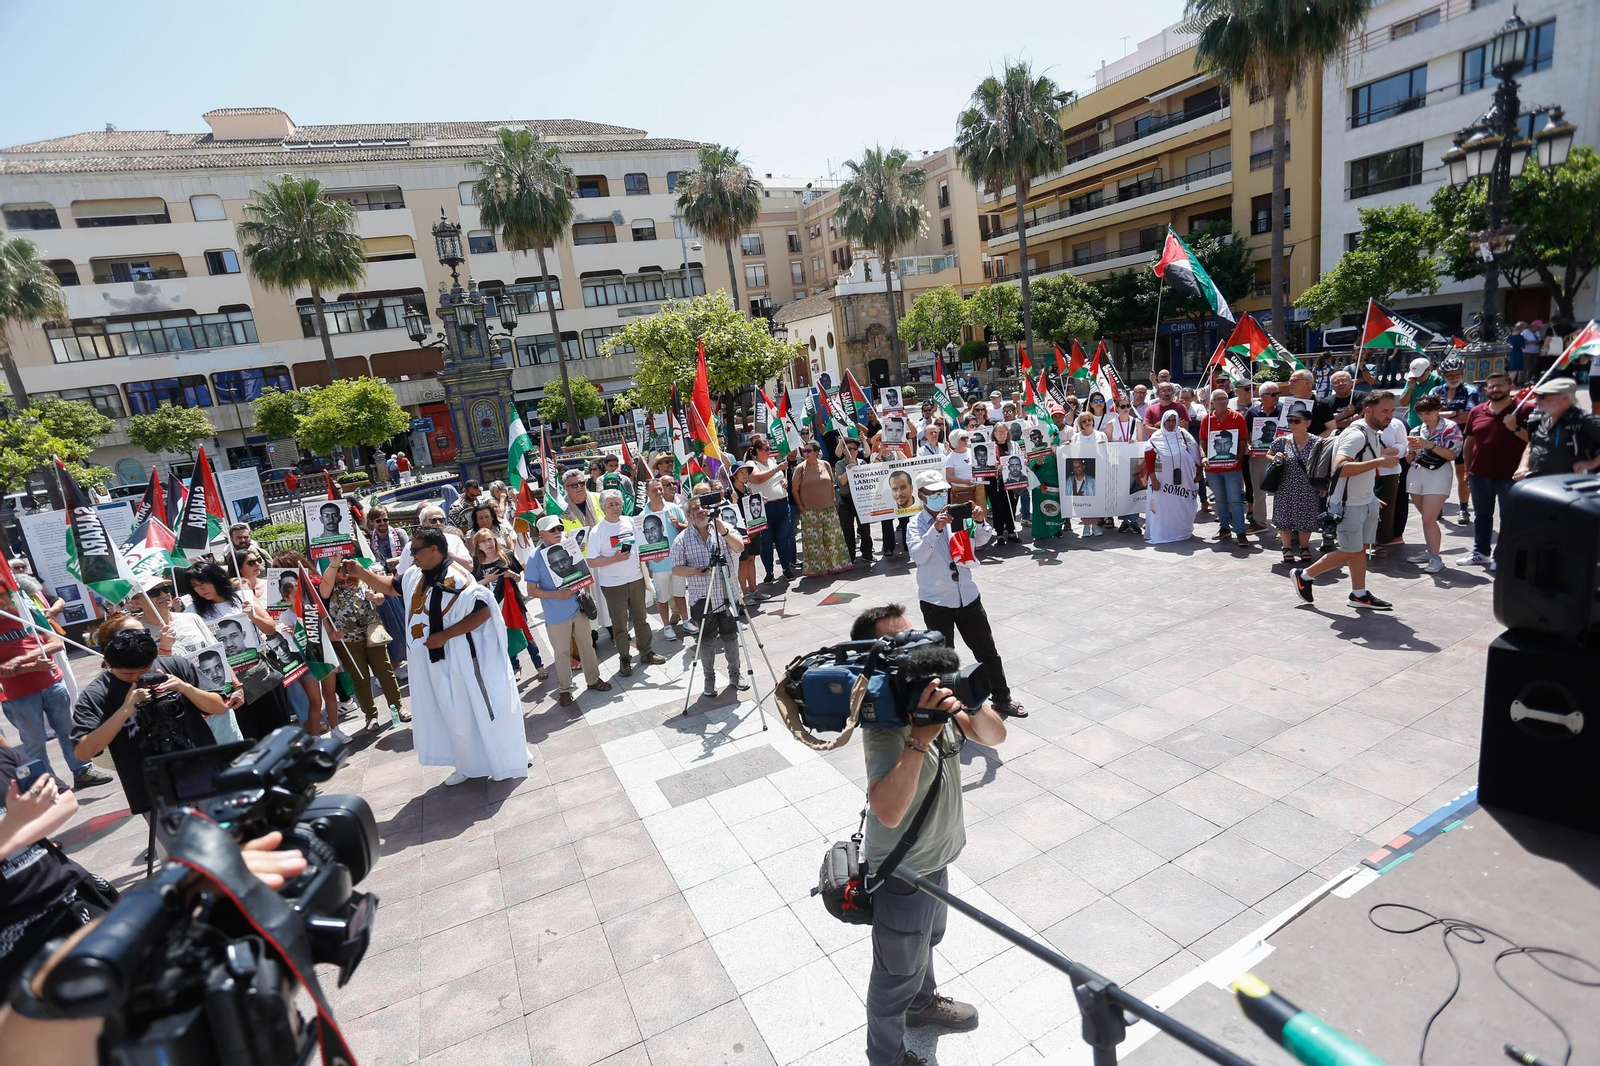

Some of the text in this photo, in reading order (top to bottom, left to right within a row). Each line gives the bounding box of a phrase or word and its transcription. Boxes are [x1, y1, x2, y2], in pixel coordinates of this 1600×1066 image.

[1391, 316, 1418, 340] SAHARA
[1395, 334, 1416, 349] LIBRE
[841, 391, 855, 416] SAHARA
[934, 391, 950, 409] LIBRE
[1050, 387, 1066, 406] SAHARA
[853, 470, 889, 479] MOHAMED
[854, 478, 880, 486] LAMINE
[1163, 484, 1190, 498] SOMOS
